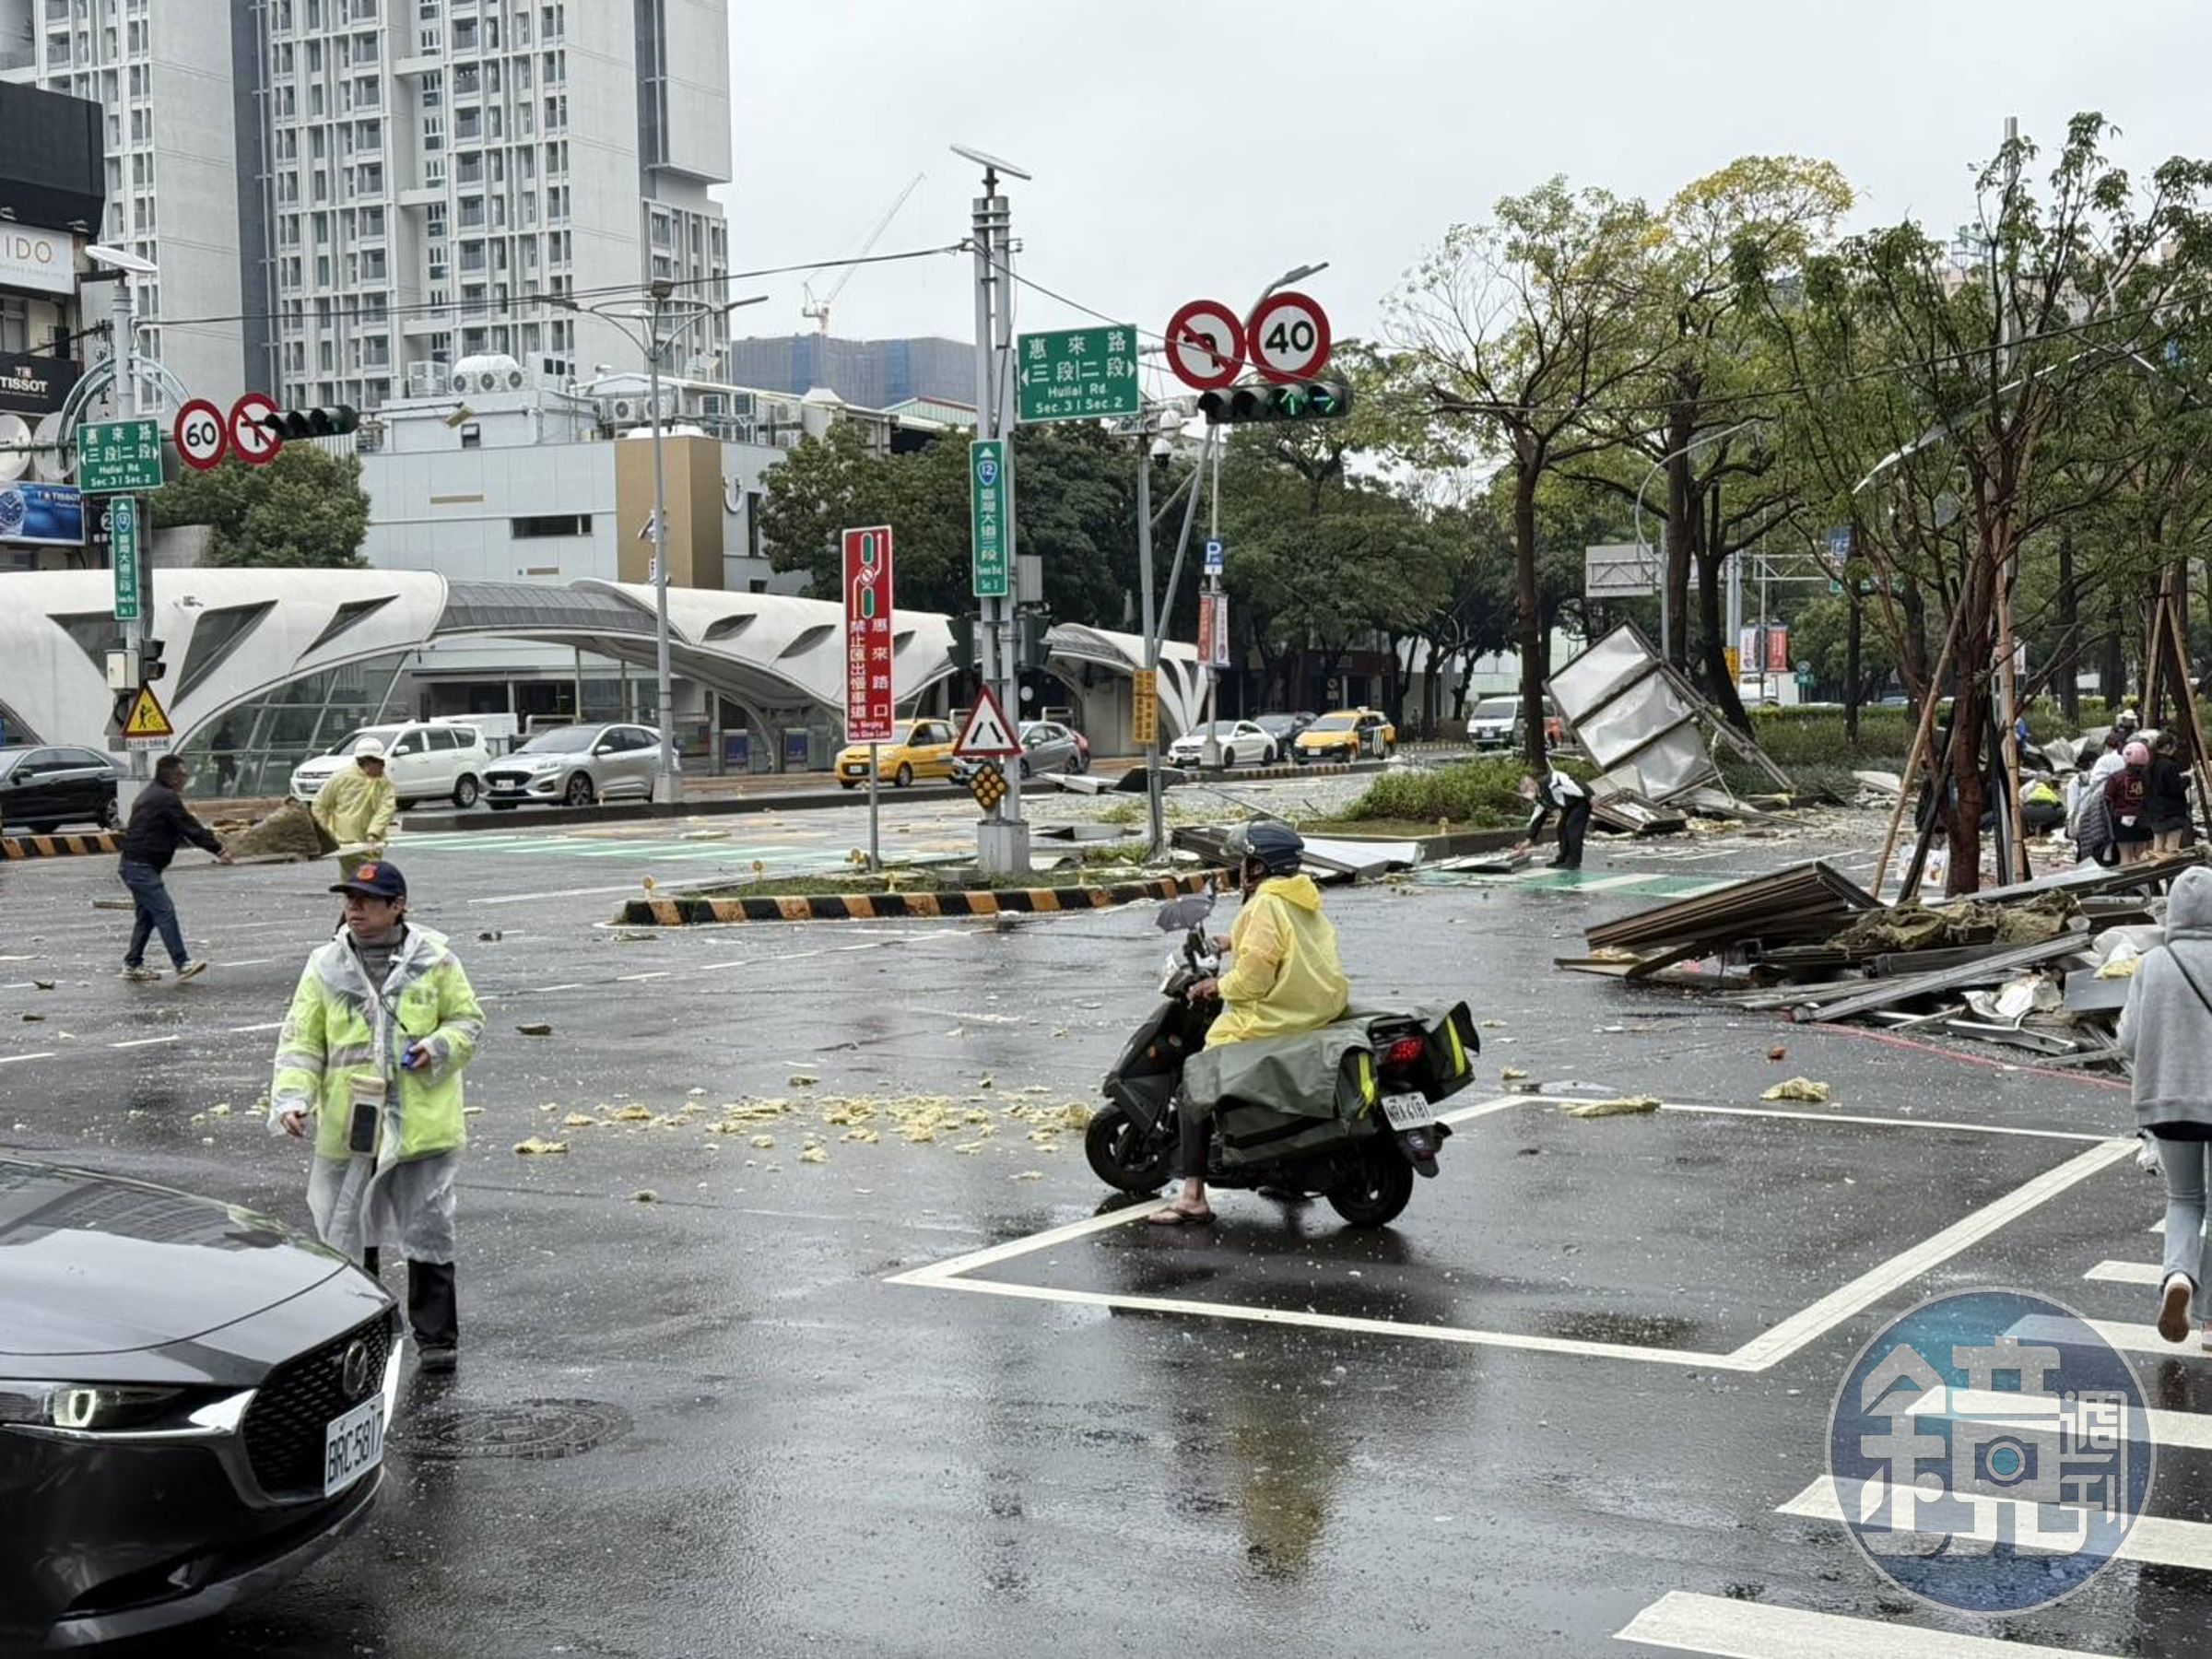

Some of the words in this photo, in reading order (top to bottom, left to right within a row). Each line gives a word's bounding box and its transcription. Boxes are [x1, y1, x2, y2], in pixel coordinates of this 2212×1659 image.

[1029, 331, 1125, 359] 惠來路
[1265, 321, 1314, 354] 40
[0, 377, 48, 393] TISSOT
[1048, 385, 1082, 398] Huilai
[86, 424, 151, 444] 惠來路
[186, 422, 217, 447] 60
[982, 465, 994, 476] 12
[1206, 542, 1221, 563] P
[872, 618, 888, 717] 惠來路口
